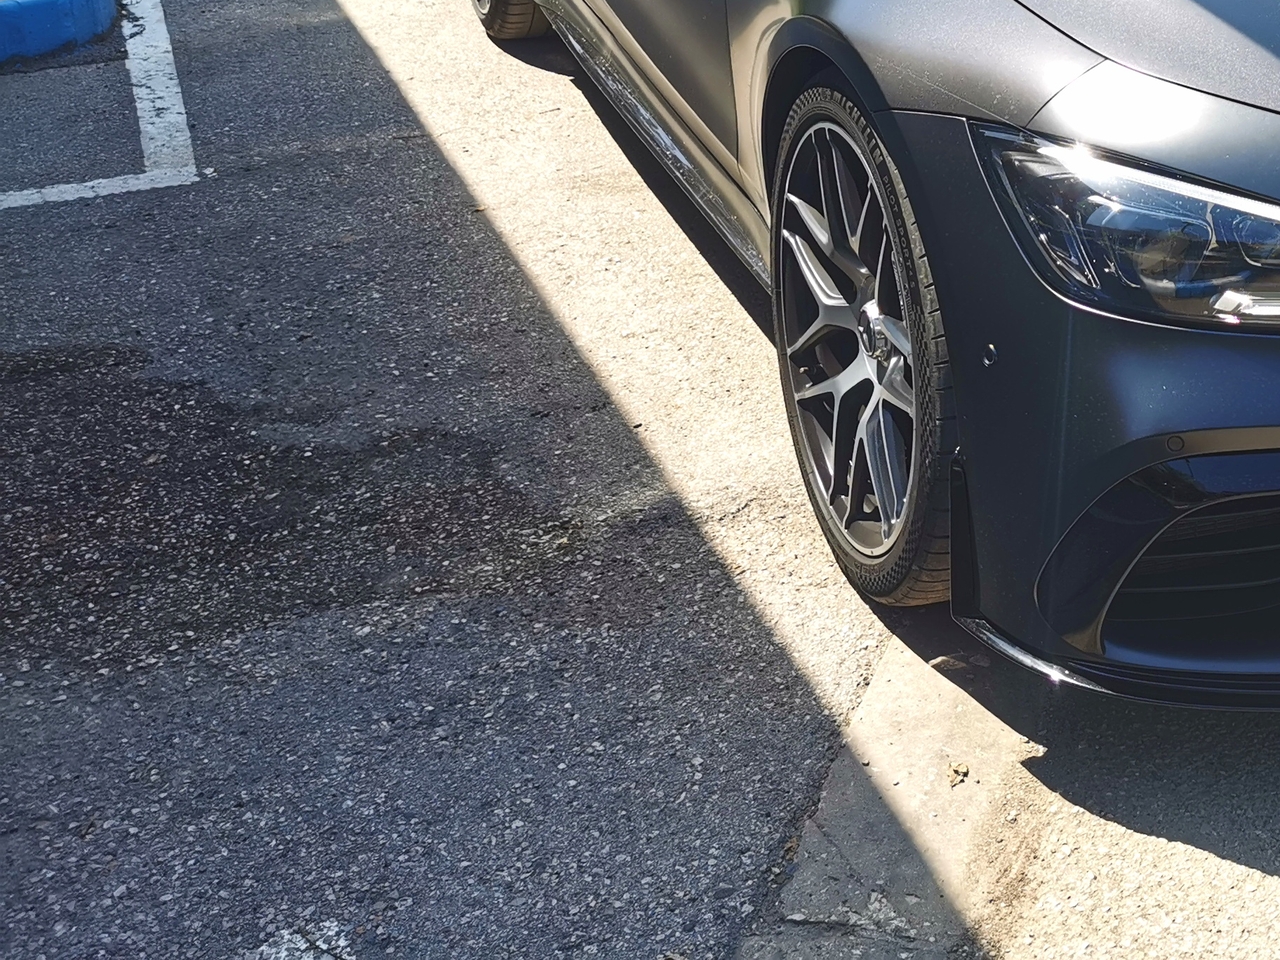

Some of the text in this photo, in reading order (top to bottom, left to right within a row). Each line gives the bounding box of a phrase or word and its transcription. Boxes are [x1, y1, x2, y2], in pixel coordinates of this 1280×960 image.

[832, 90, 884, 165] MICHELIN
[882, 175, 898, 213] PILOT
[896, 219, 912, 269] SPORT
